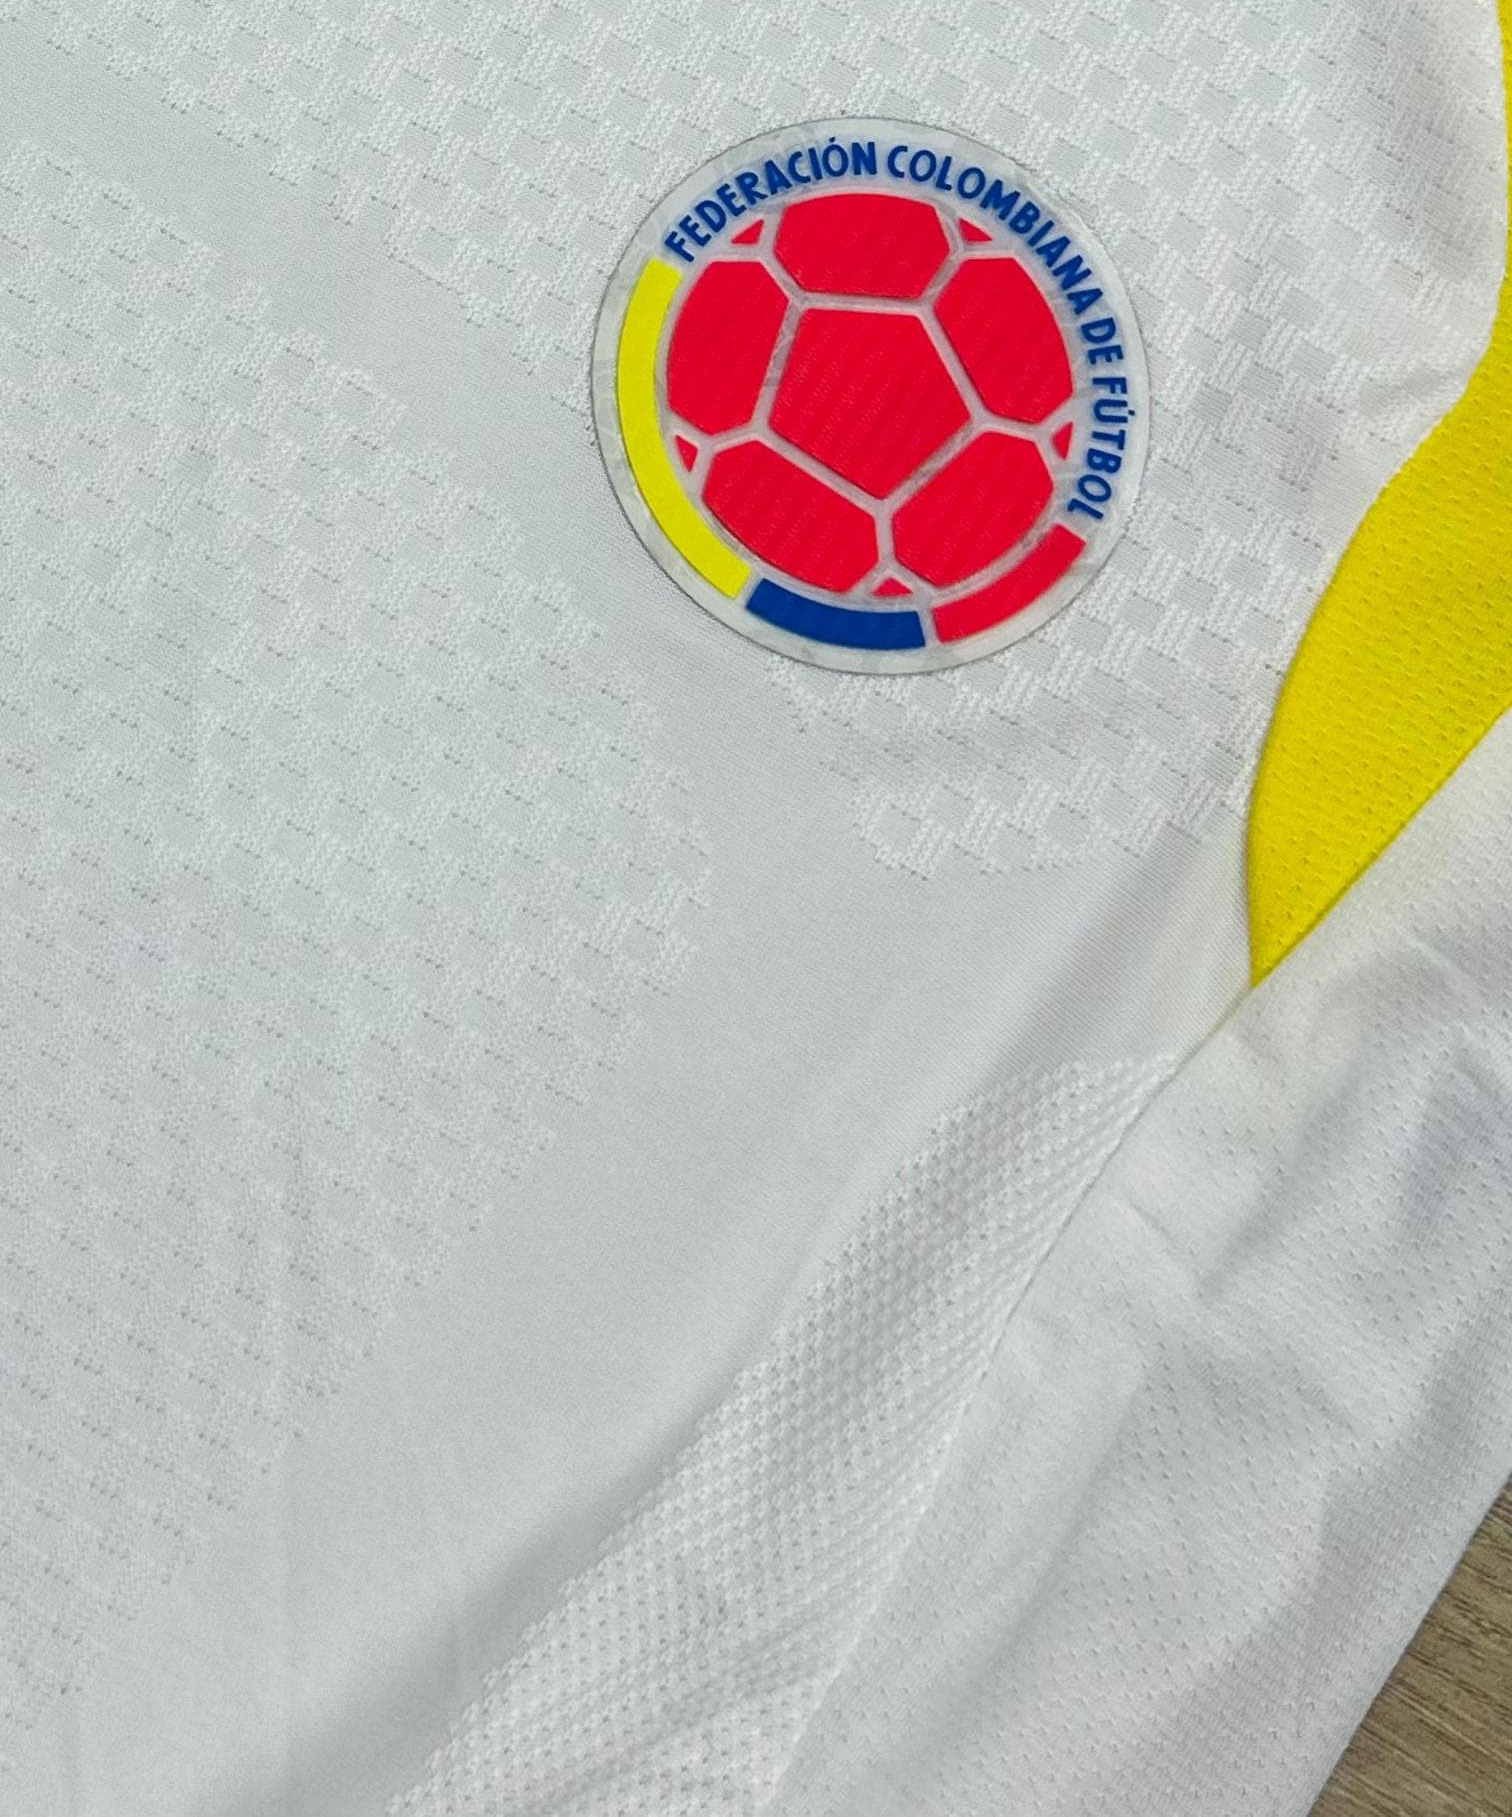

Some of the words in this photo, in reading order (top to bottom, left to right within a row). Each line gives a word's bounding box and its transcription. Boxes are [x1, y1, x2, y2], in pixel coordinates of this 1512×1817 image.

[663, 137, 877, 263] FEDERACIÓN
[887, 144, 1103, 316] COLOMBIANA
[1080, 315, 1124, 365] DE
[1067, 374, 1136, 520] FÚTBOL
